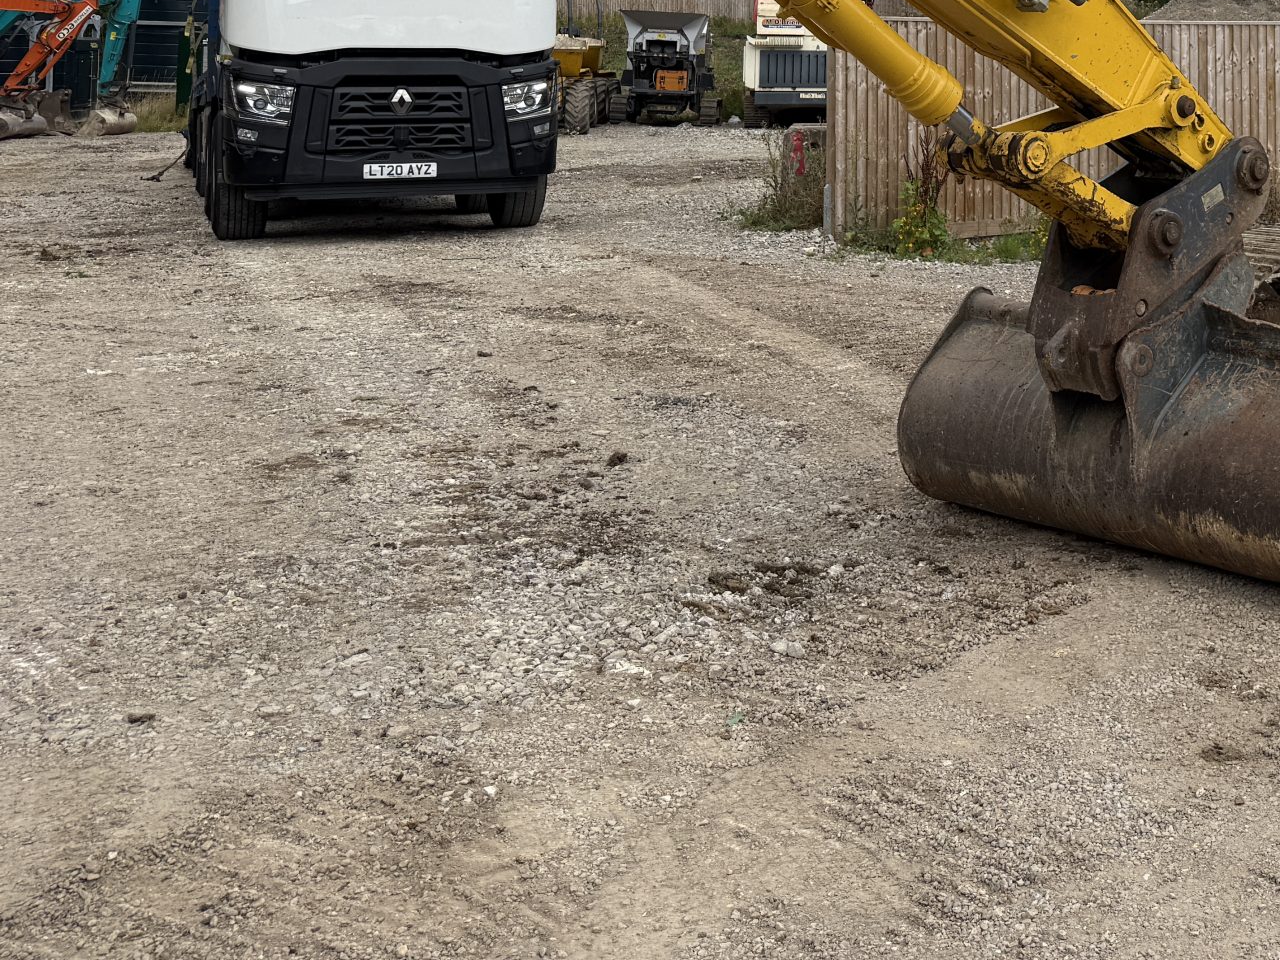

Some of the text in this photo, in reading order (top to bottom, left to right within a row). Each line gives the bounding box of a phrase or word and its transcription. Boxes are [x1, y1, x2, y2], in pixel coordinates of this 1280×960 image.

[57, 23, 75, 39] eco
[369, 164, 432, 177] LT20 AYZ
